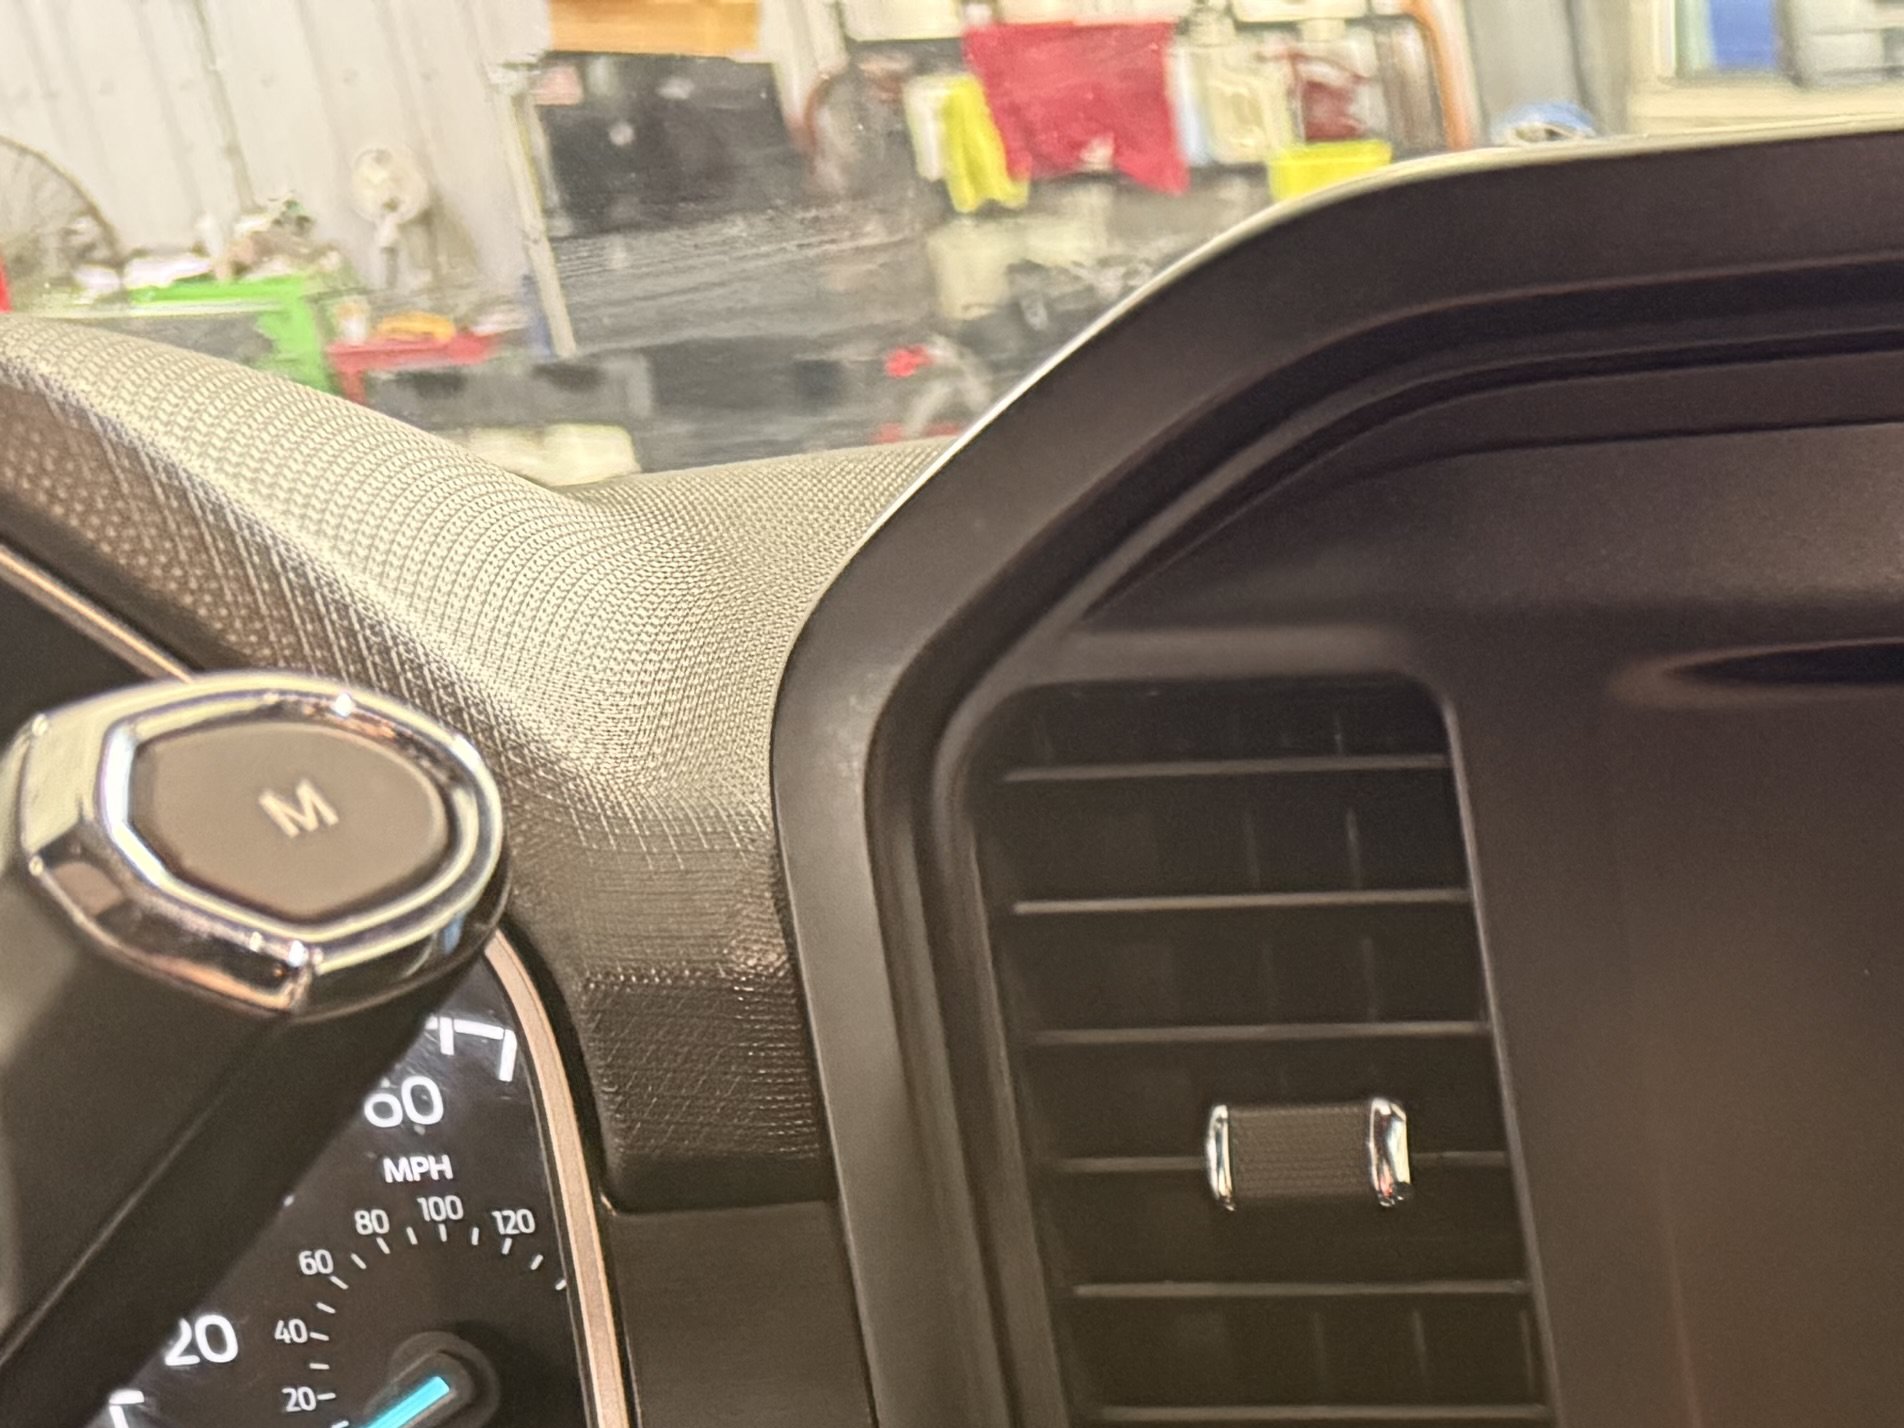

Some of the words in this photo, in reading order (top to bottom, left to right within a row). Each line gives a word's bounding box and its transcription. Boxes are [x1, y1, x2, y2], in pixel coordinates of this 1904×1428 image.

[258, 777, 340, 839] M
[382, 1154, 453, 1183] MPH
[417, 1195, 464, 1222] 100
[491, 1208, 536, 1236] 120
[354, 1209, 390, 1236] 80
[299, 1250, 334, 1276] 60
[274, 1320, 308, 1345] 40
[281, 1387, 317, 1412] 20
